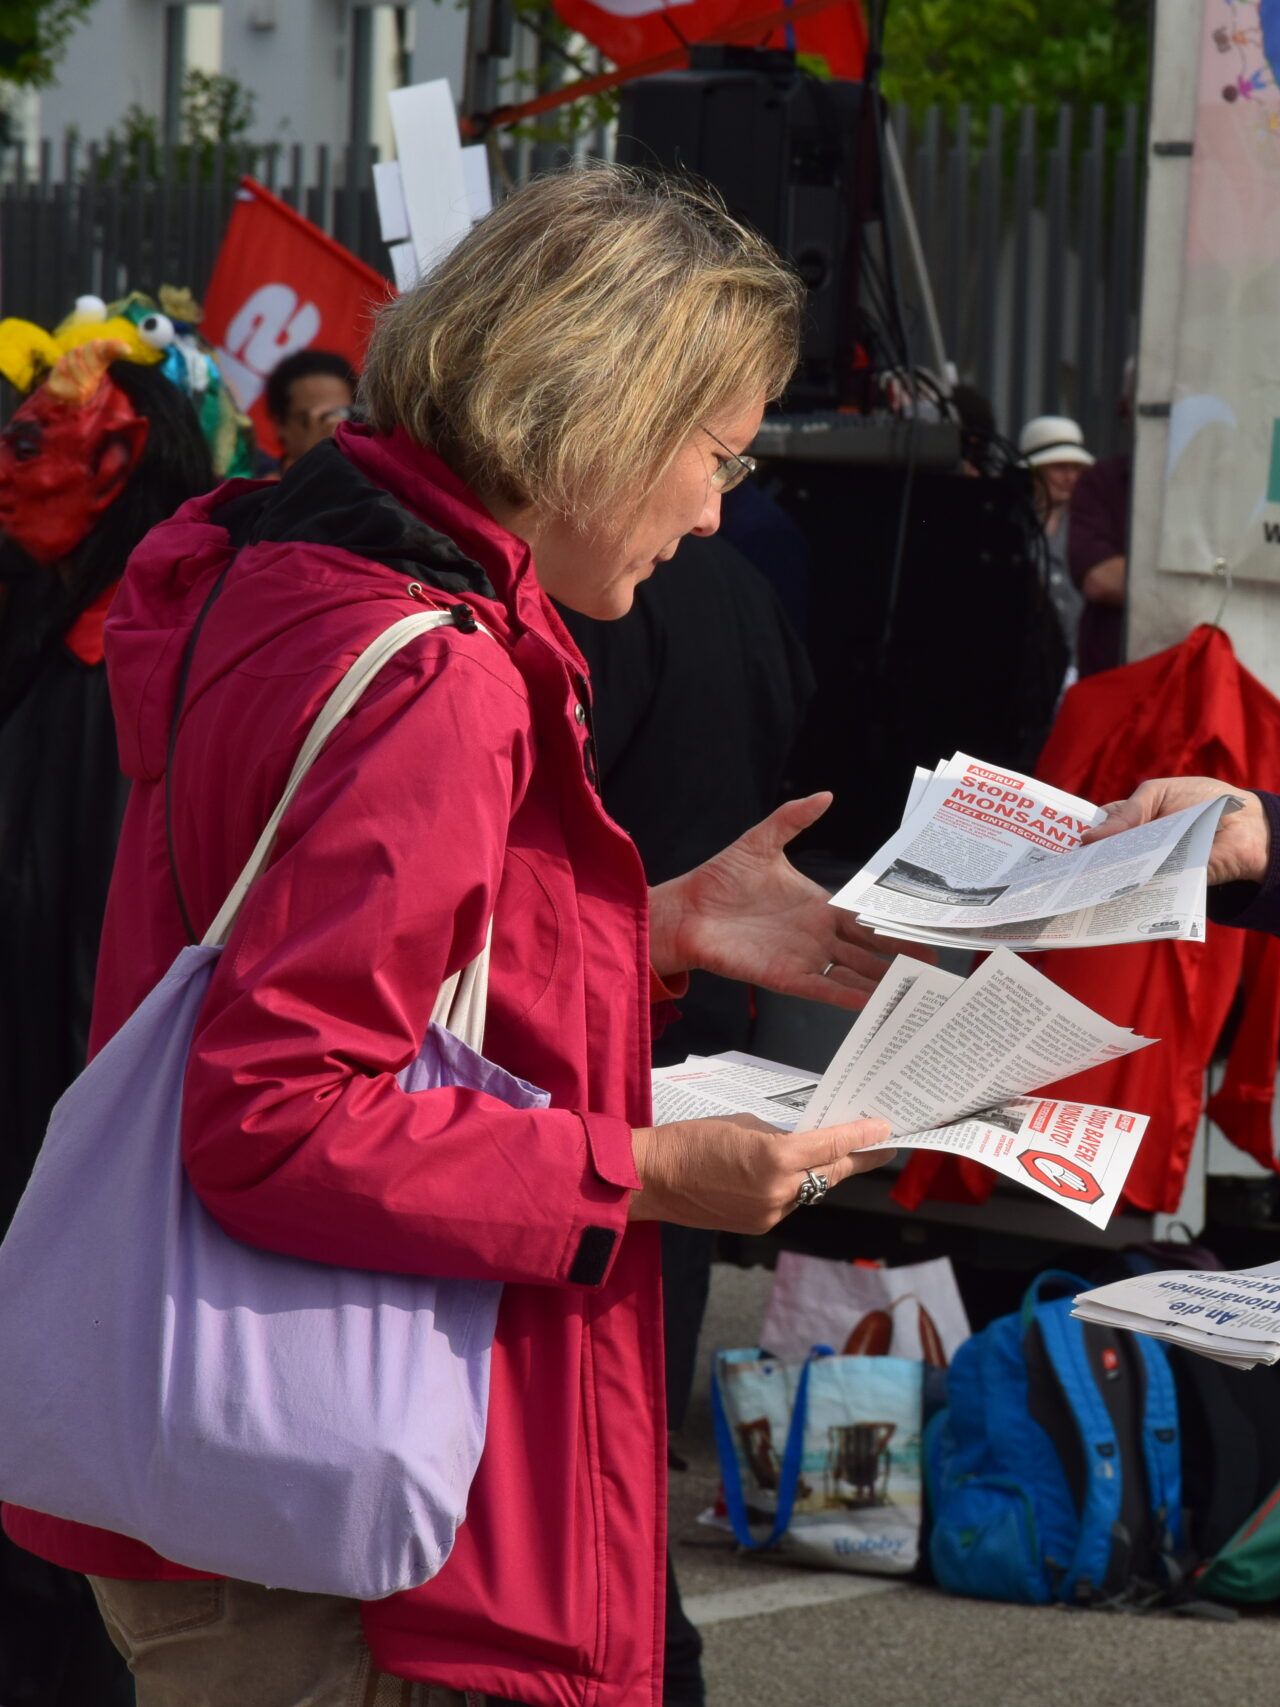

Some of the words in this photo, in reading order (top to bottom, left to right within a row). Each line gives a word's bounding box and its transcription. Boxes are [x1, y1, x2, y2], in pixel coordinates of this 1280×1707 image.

[970, 765, 1021, 789] AUFRUF
[960, 775, 1035, 810] Stopp
[945, 800, 978, 818] JETZT
[951, 787, 1081, 848] MONSANT
[1168, 1301, 1201, 1317] die
[1205, 1309, 1239, 1326] An
